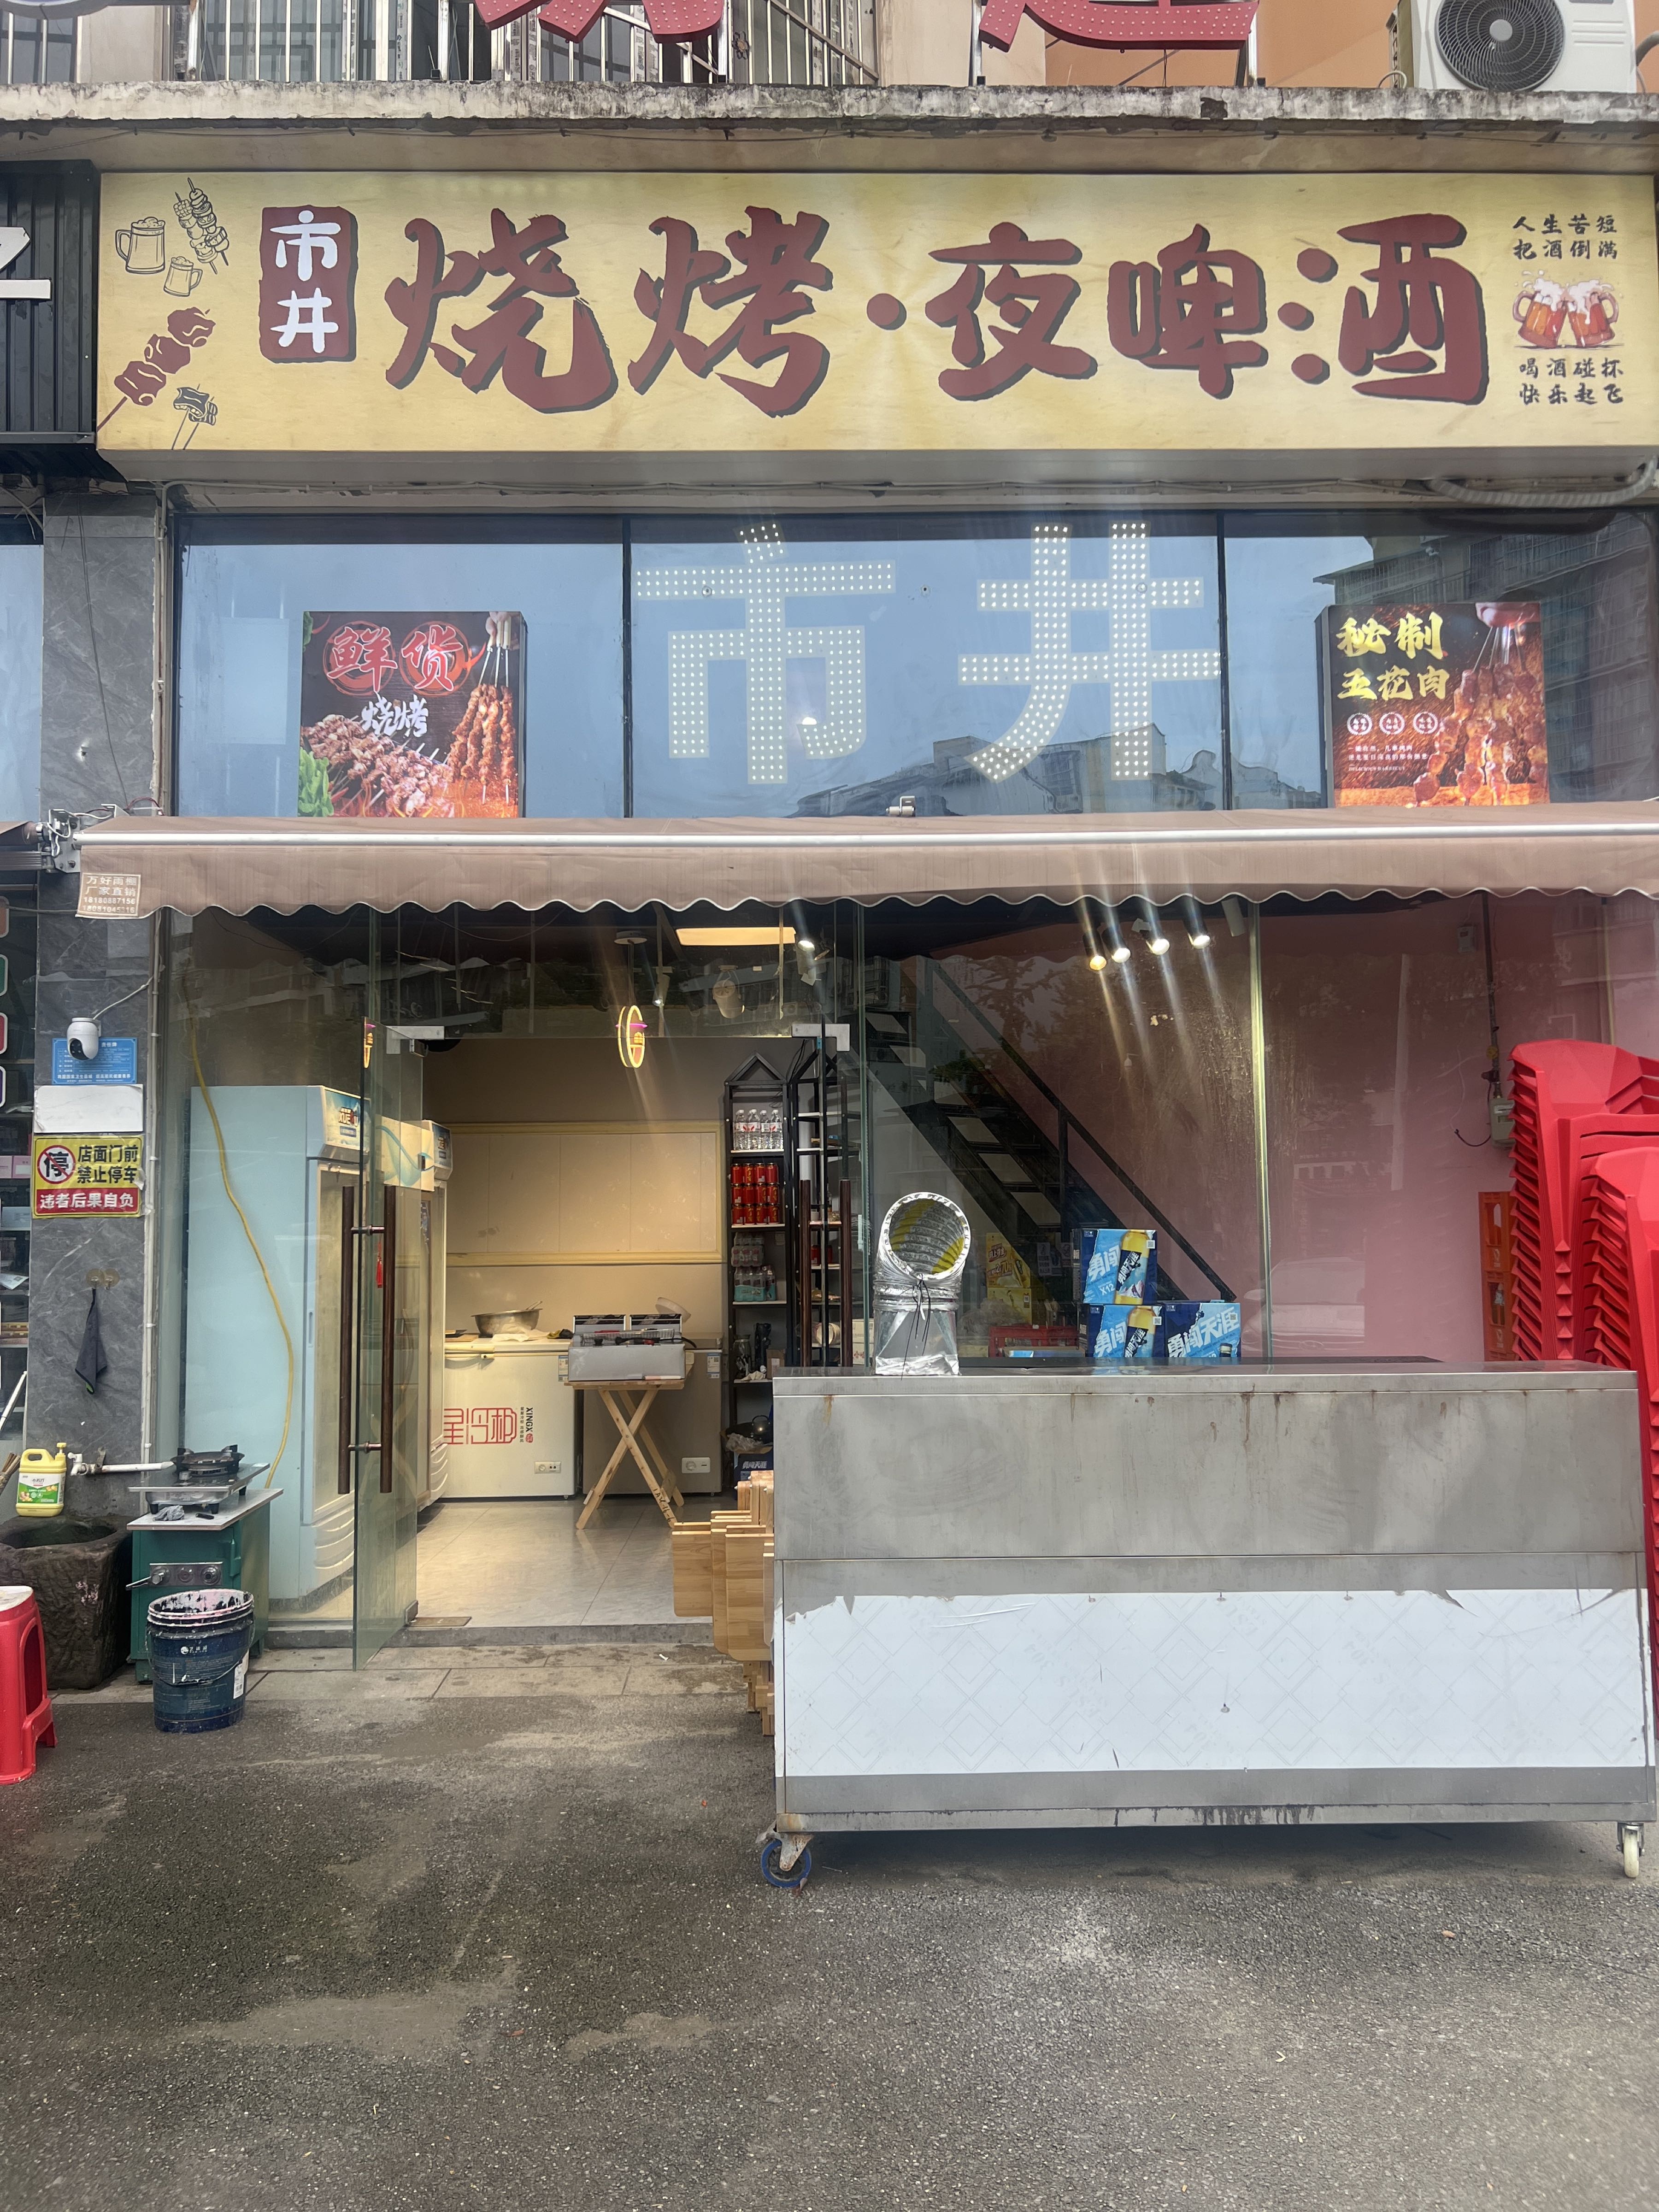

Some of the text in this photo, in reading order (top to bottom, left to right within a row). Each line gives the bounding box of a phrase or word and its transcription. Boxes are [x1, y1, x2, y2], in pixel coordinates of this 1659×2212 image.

[1513, 214, 1617, 234] 人生苦短
[1513, 240, 1618, 259] 把酒倒满
[270, 210, 341, 353] 市井
[1520, 358, 1624, 378] 喝酒碰杯
[1520, 383, 1624, 405] 快乐起飞
[1336, 612, 1443, 659] 秘制
[327, 625, 463, 693] 鲜货
[635, 520, 1221, 784] 市井
[1337, 665, 1449, 700] 五花肉
[361, 692, 429, 737] 烧烤
[85, 886, 136, 897] 厂家直销
[87, 876, 136, 886] 万好雨棚
[43, 1151, 69, 1177] 停
[78, 1145, 138, 1163] 店面门前
[77, 1165, 137, 1183] 禁止停车
[40, 1192, 134, 1209] 违者后果自负
